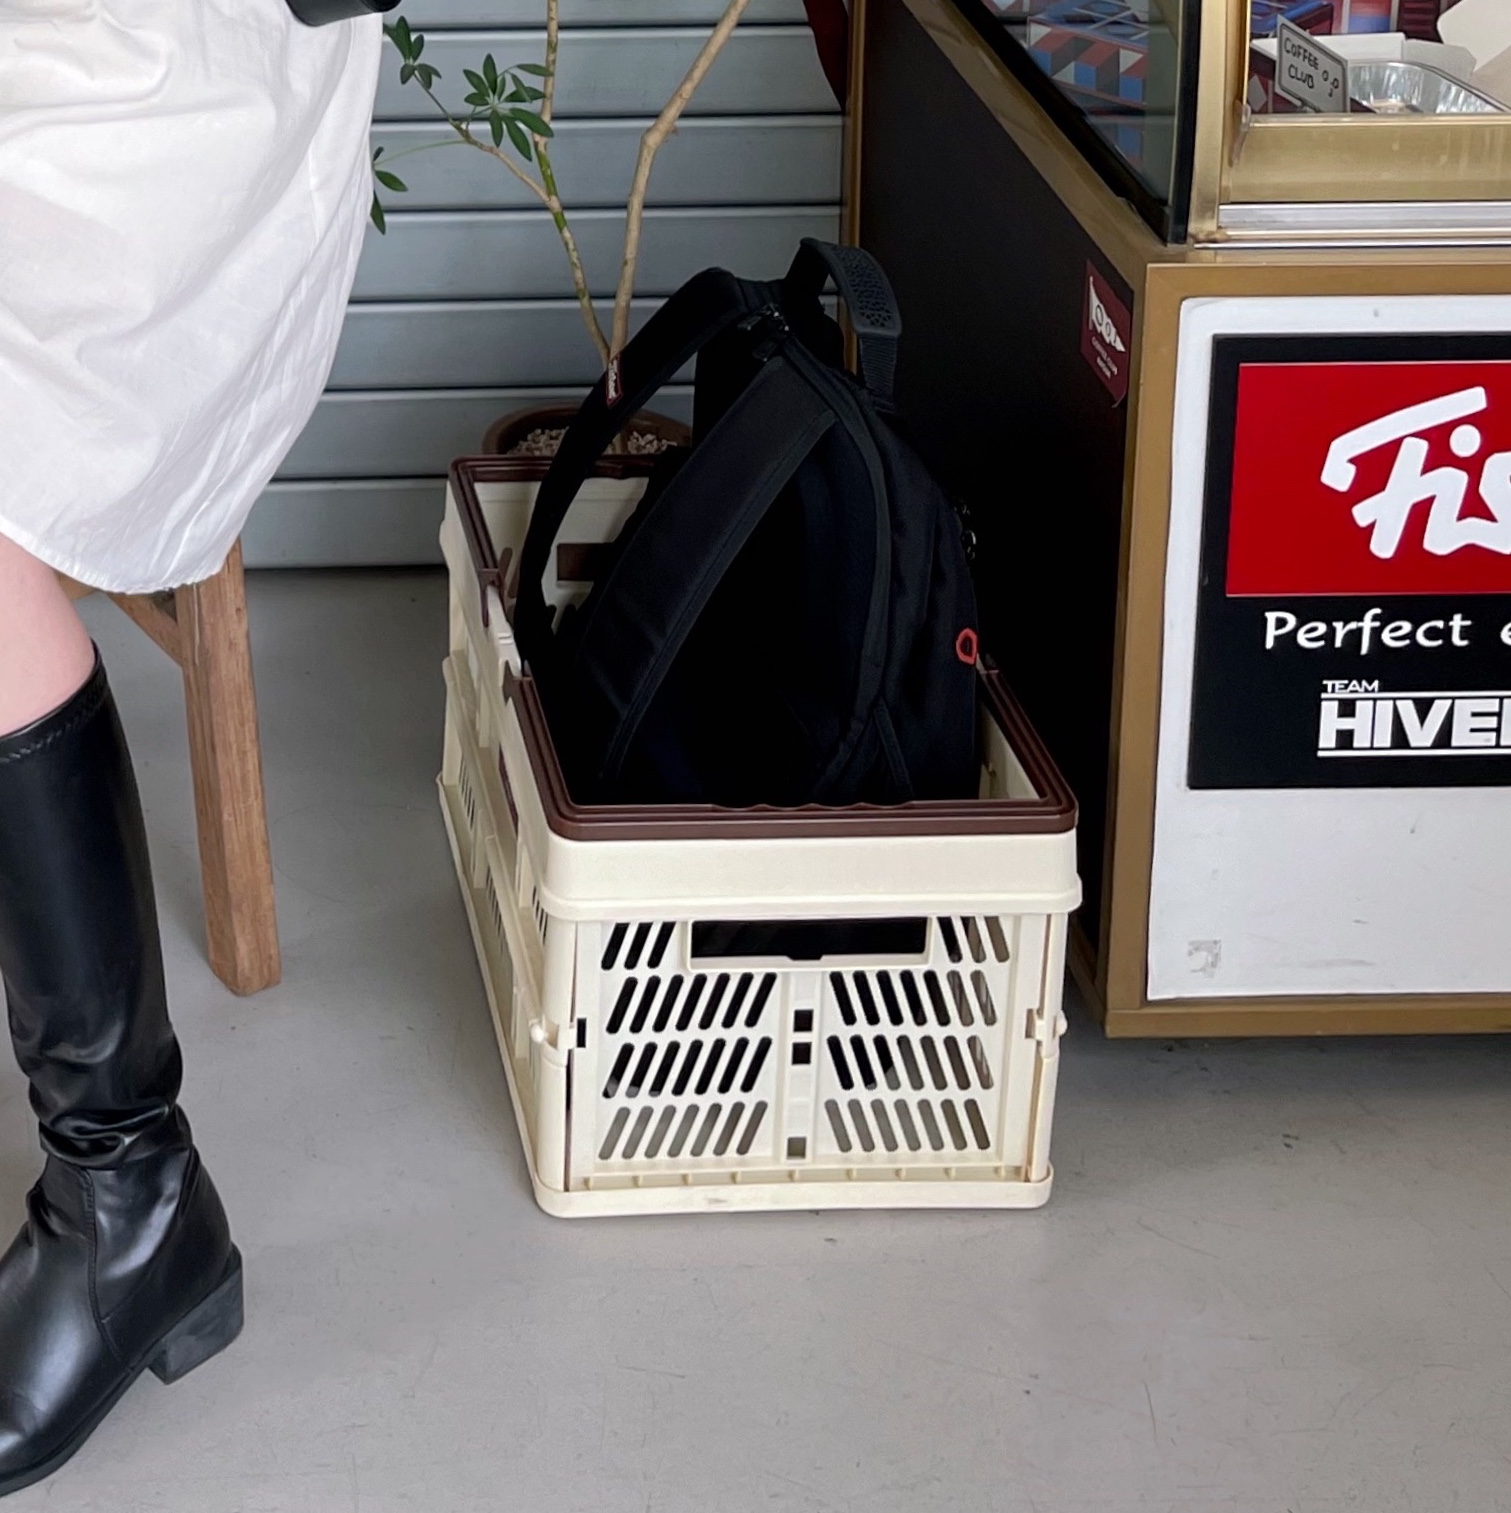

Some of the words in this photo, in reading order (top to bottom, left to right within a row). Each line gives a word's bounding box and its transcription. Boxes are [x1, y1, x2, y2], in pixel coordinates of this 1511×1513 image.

[1284, 37, 1319, 70] COFFEE
[1288, 64, 1314, 89] CLUB
[1264, 607, 1473, 656] Perfect
[1322, 679, 1380, 693] TEAM
[1318, 698, 1511, 749] HIVE
